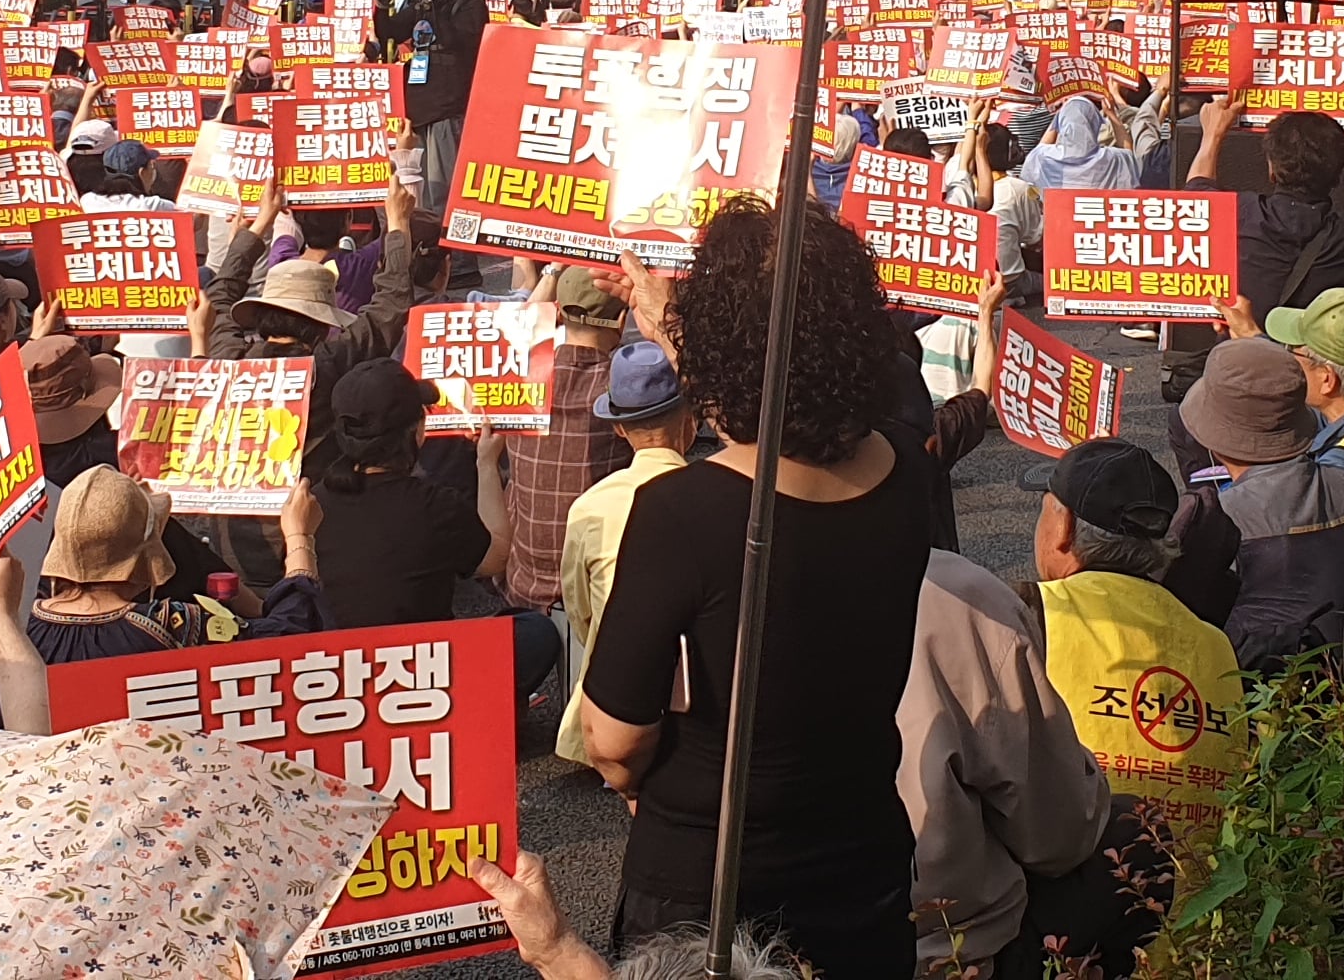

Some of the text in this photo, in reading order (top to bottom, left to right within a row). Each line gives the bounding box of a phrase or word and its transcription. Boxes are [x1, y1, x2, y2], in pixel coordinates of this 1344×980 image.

[837, 42, 902, 63] 투표항쟁
[946, 30, 1008, 50] 투표항쟁
[131, 90, 194, 110] 투표항쟁
[132, 109, 196, 129] 떨쳐나서
[296, 101, 381, 133] 투표항쟁
[296, 131, 388, 161] 떨쳐나서
[857, 150, 930, 186] 투표항쟁
[461, 161, 612, 221] 내란세력
[865, 200, 978, 243] 투표항쟁
[1073, 196, 1211, 232] 투표항쟁
[60, 220, 177, 251] 투표항쟁
[865, 229, 977, 272] 떨쳐나서
[1073, 231, 1211, 269] 떨쳐나서
[65, 251, 181, 283] 떨쳐나서
[1050, 267, 1230, 299] 내란세력 응징하자!
[420, 345, 529, 378] 떨쳐나서
[473, 383, 545, 407] 응징하자!
[1088, 685, 1231, 737] 조선일보
[1113, 753, 1183, 786] 휘두르는
[347, 823, 498, 898] 징하자!
[328, 918, 412, 945] 촛불대행진으로
[415, 912, 454, 931] 모이자!
[323, 949, 341, 966] ARS
[460, 929, 477, 942] 여러
